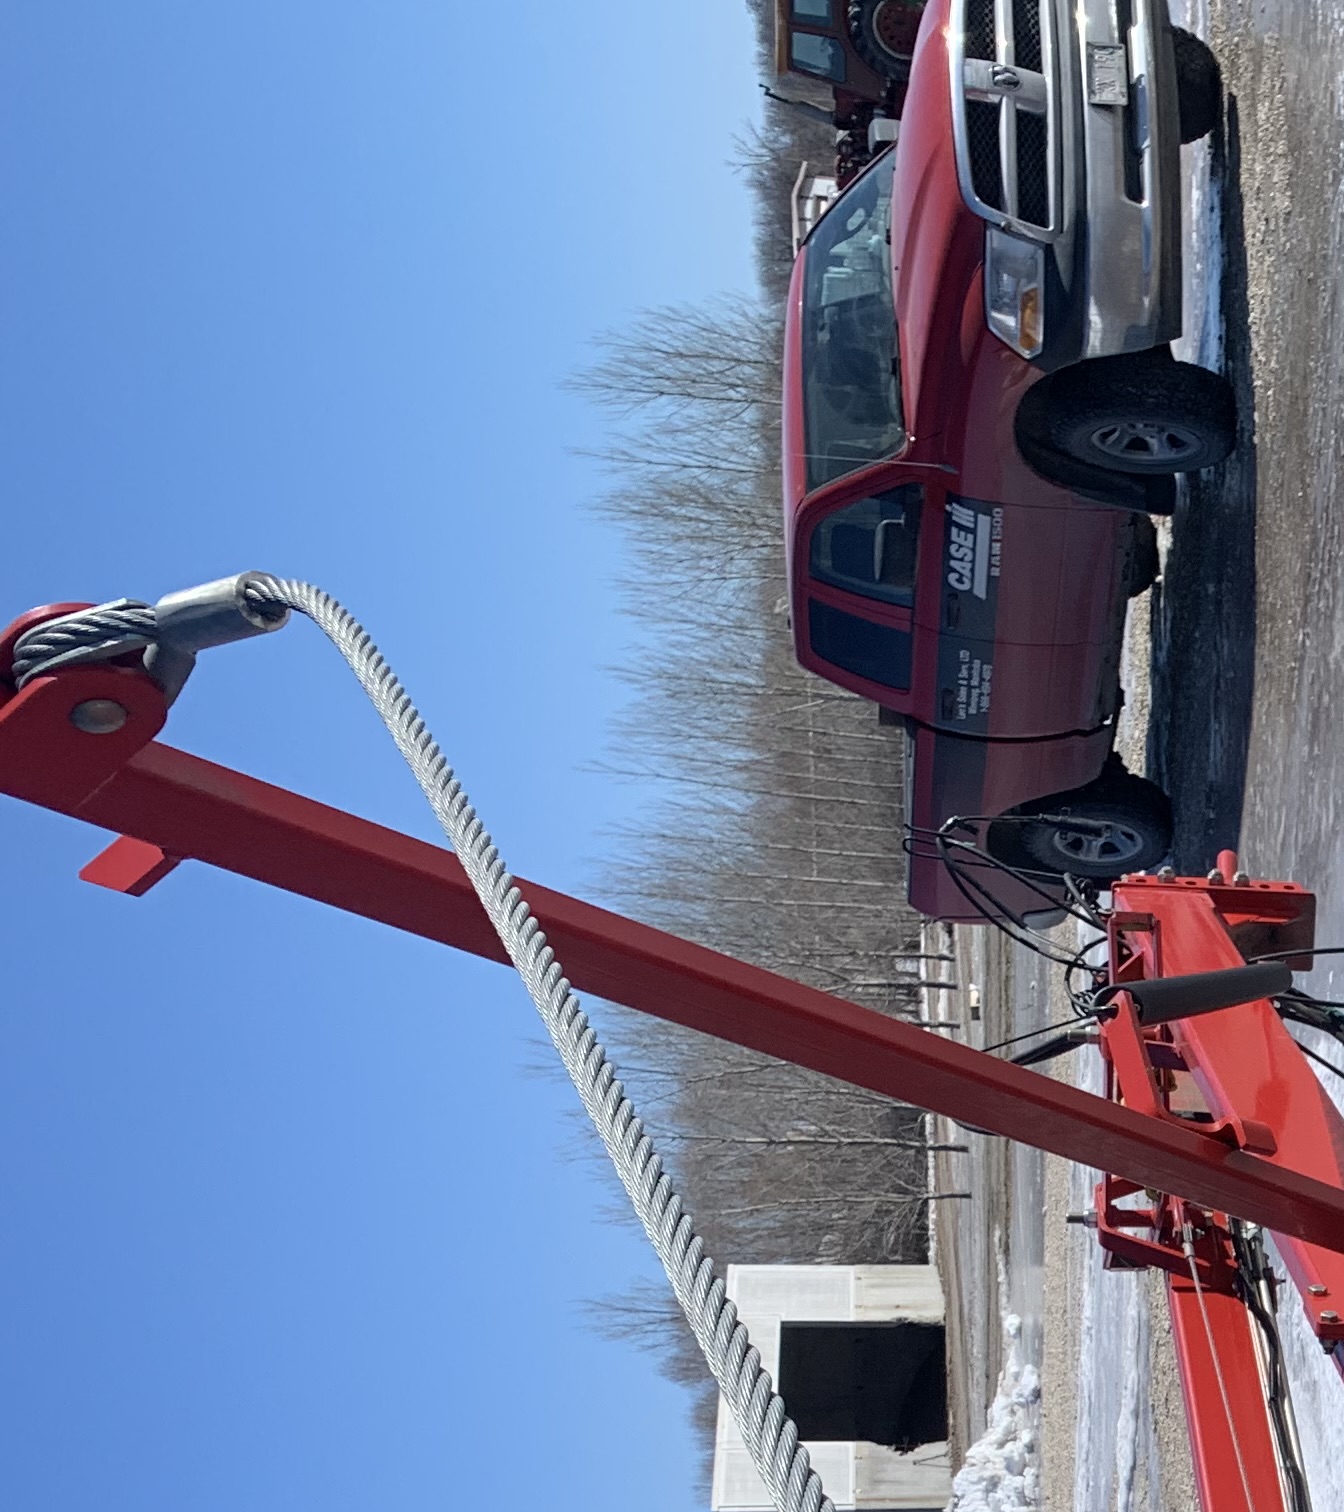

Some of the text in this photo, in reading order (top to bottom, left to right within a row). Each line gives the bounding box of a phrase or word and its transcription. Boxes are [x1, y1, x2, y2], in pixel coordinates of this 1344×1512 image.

[947, 527, 975, 591] CASE
[990, 507, 1004, 577] RAM 1500
